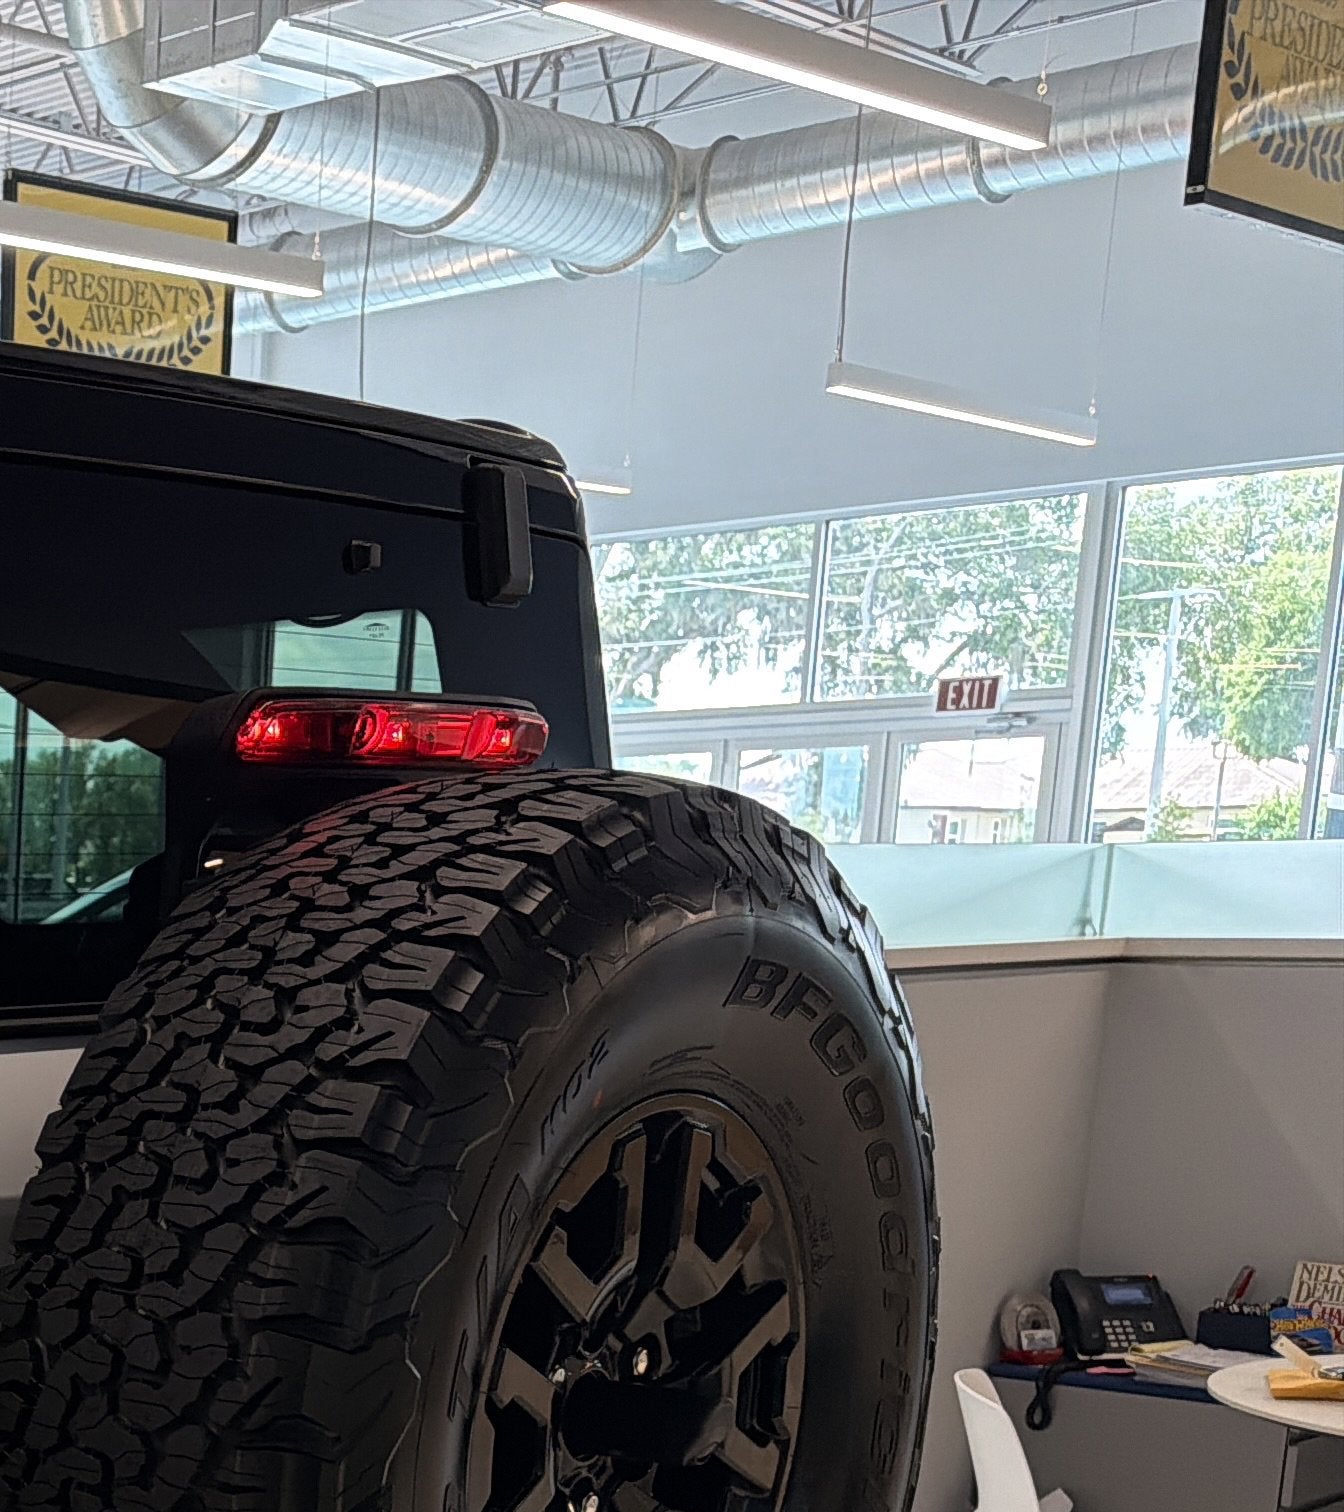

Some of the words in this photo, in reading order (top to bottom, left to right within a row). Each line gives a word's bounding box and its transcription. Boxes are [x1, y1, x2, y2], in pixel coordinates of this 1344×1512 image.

[46, 265, 201, 315] PRESIDENT'S
[79, 303, 163, 339] AWARD
[946, 679, 993, 710] EXIT
